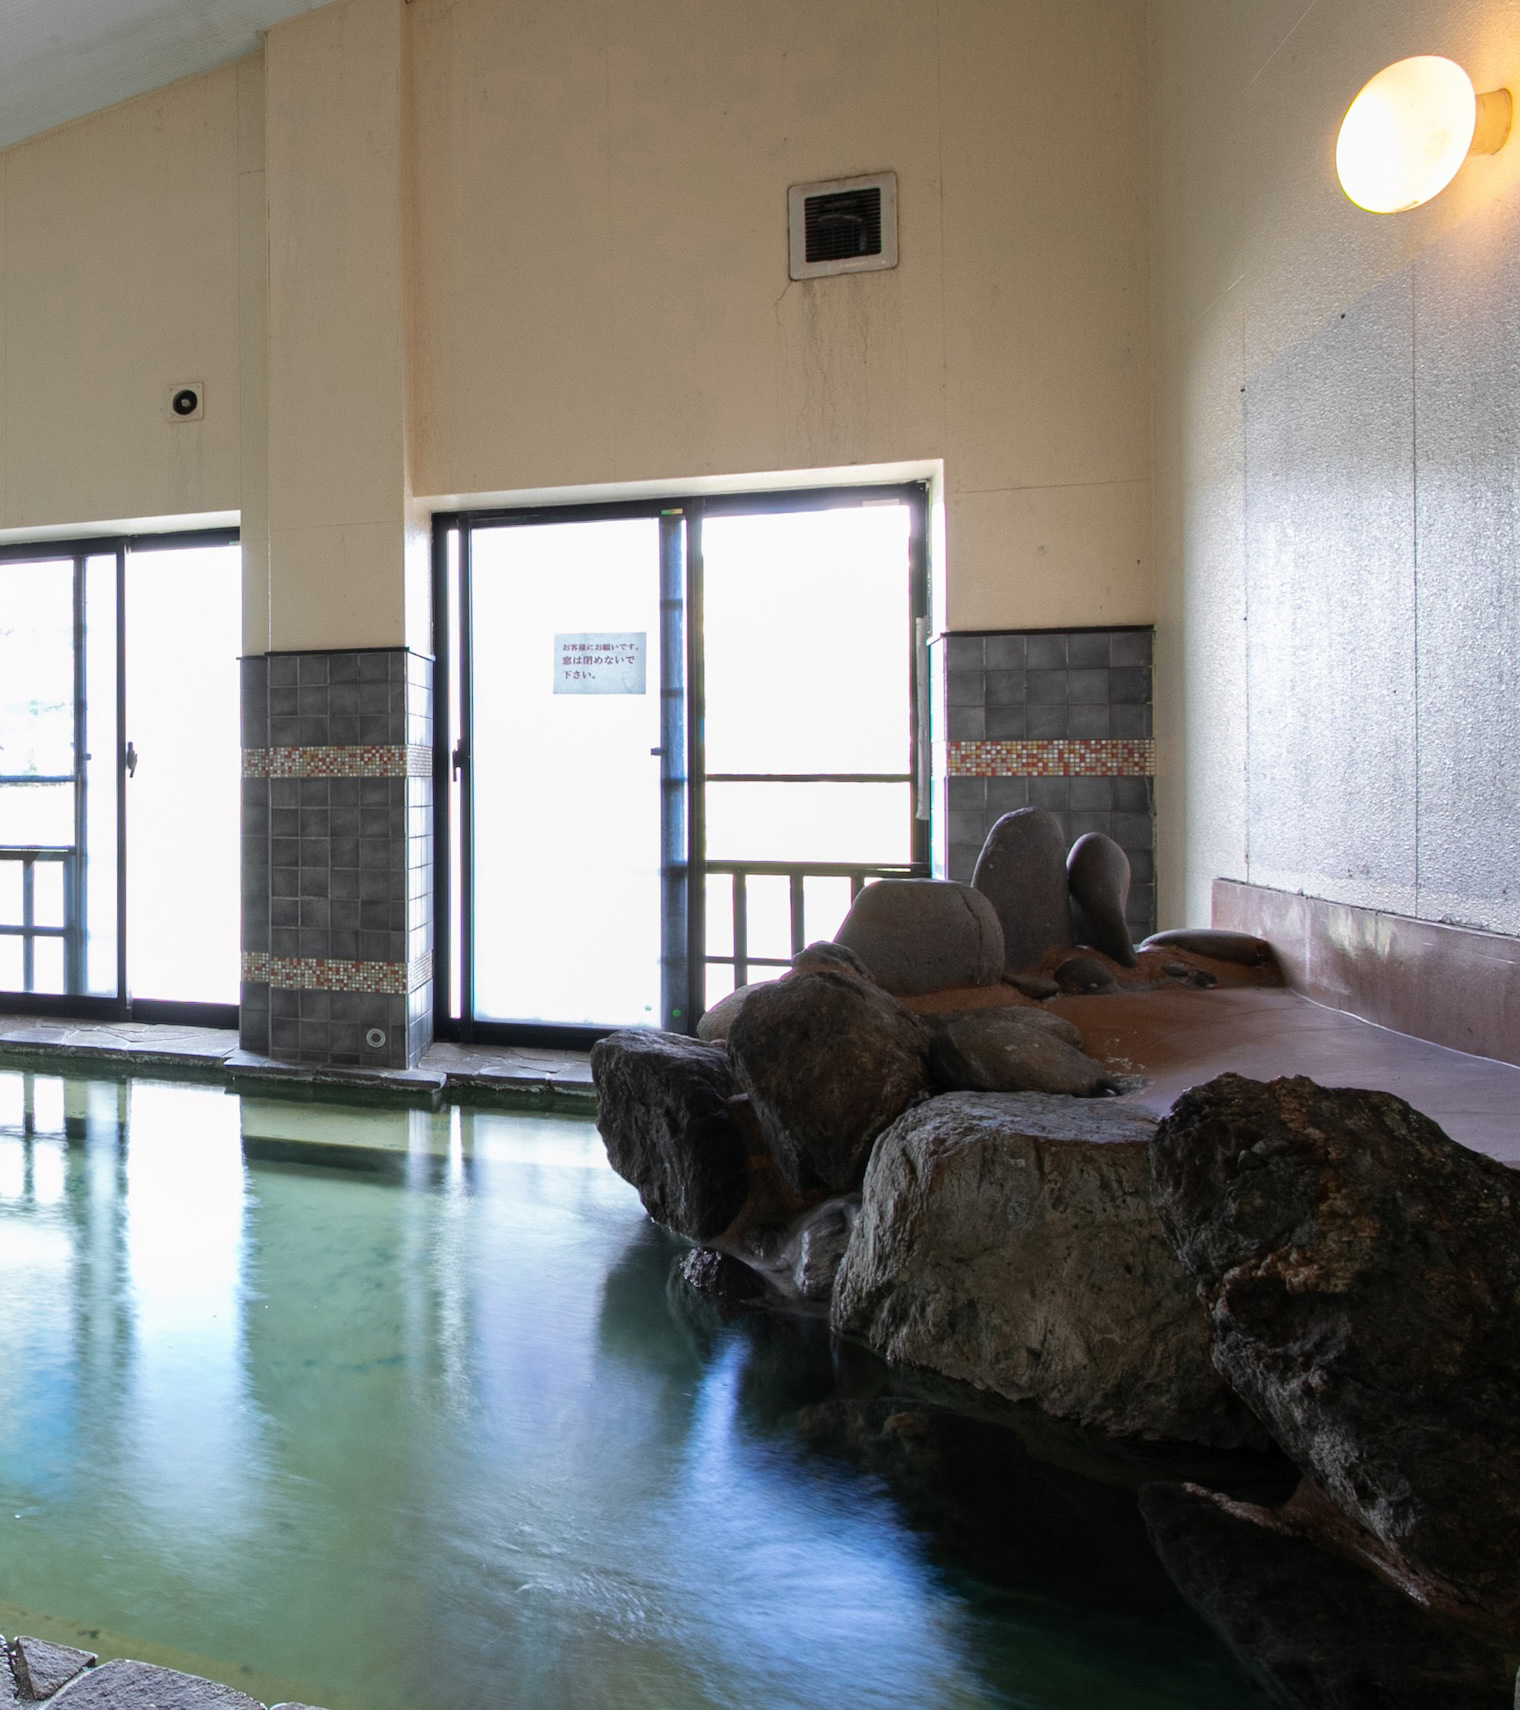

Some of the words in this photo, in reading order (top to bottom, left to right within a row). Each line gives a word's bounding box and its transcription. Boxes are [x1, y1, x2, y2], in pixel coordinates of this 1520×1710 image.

[562, 643, 639, 651] お客様にお願いです。
[562, 655, 635, 665] 窓は閉めないで
[562, 670, 596, 679] 下さい。
